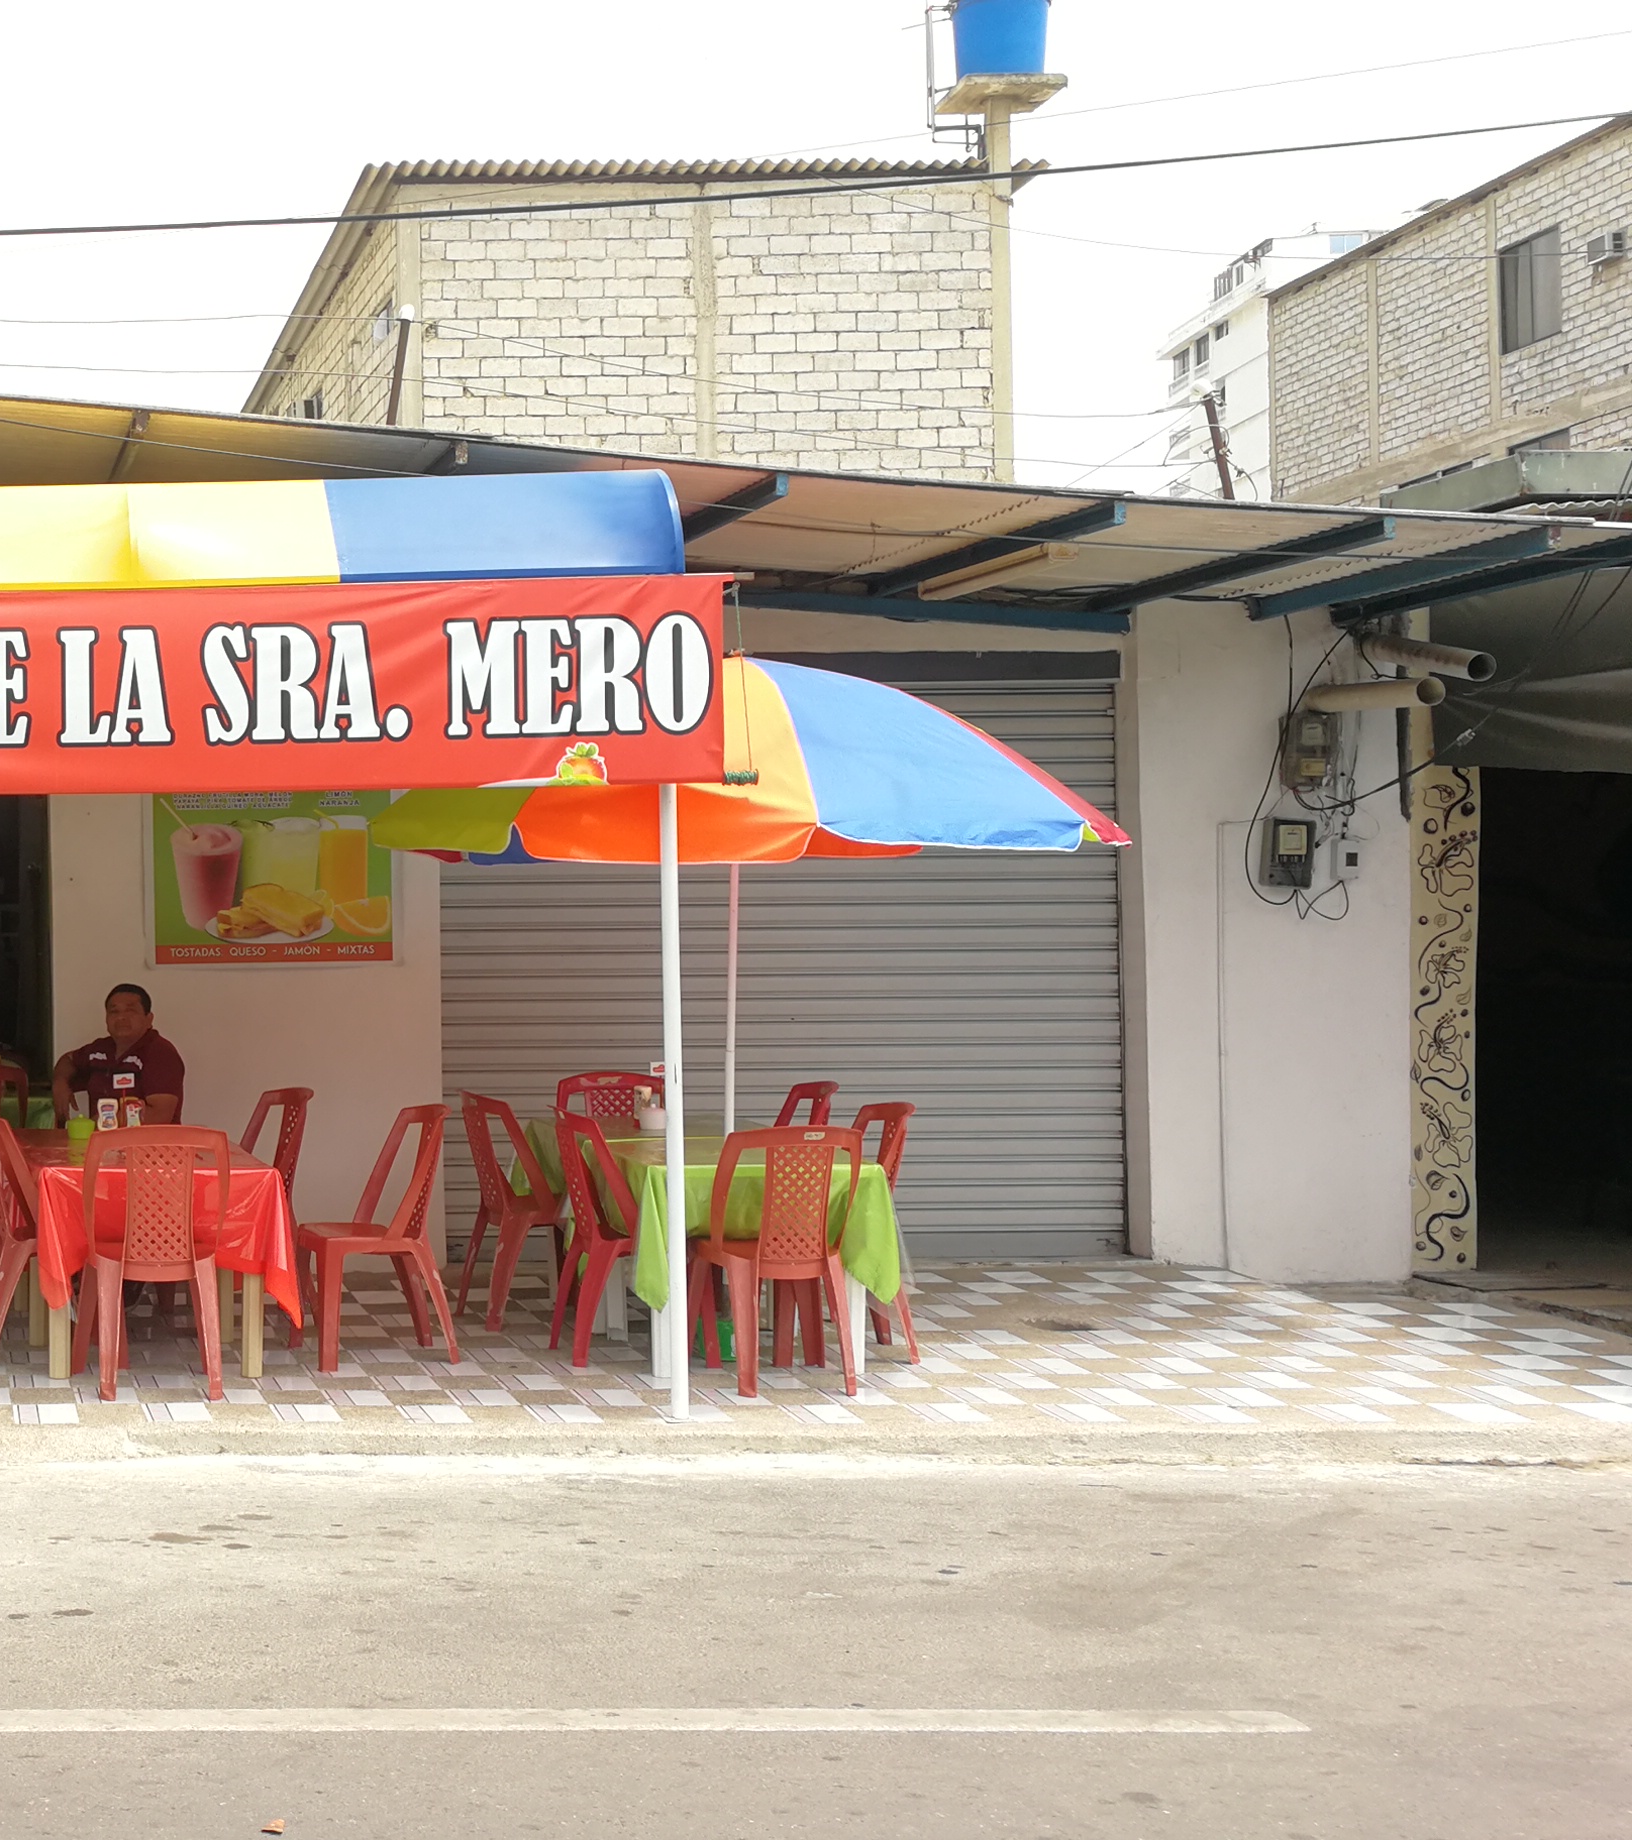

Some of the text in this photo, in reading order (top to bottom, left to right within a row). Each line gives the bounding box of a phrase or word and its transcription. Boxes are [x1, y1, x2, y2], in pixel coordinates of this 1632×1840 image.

[56, 625, 175, 748] LA
[200, 619, 413, 747] SRA.
[442, 610, 713, 739] MERO
[229, 946, 267, 957] QUESO
[337, 944, 375, 955] MIXTAS
